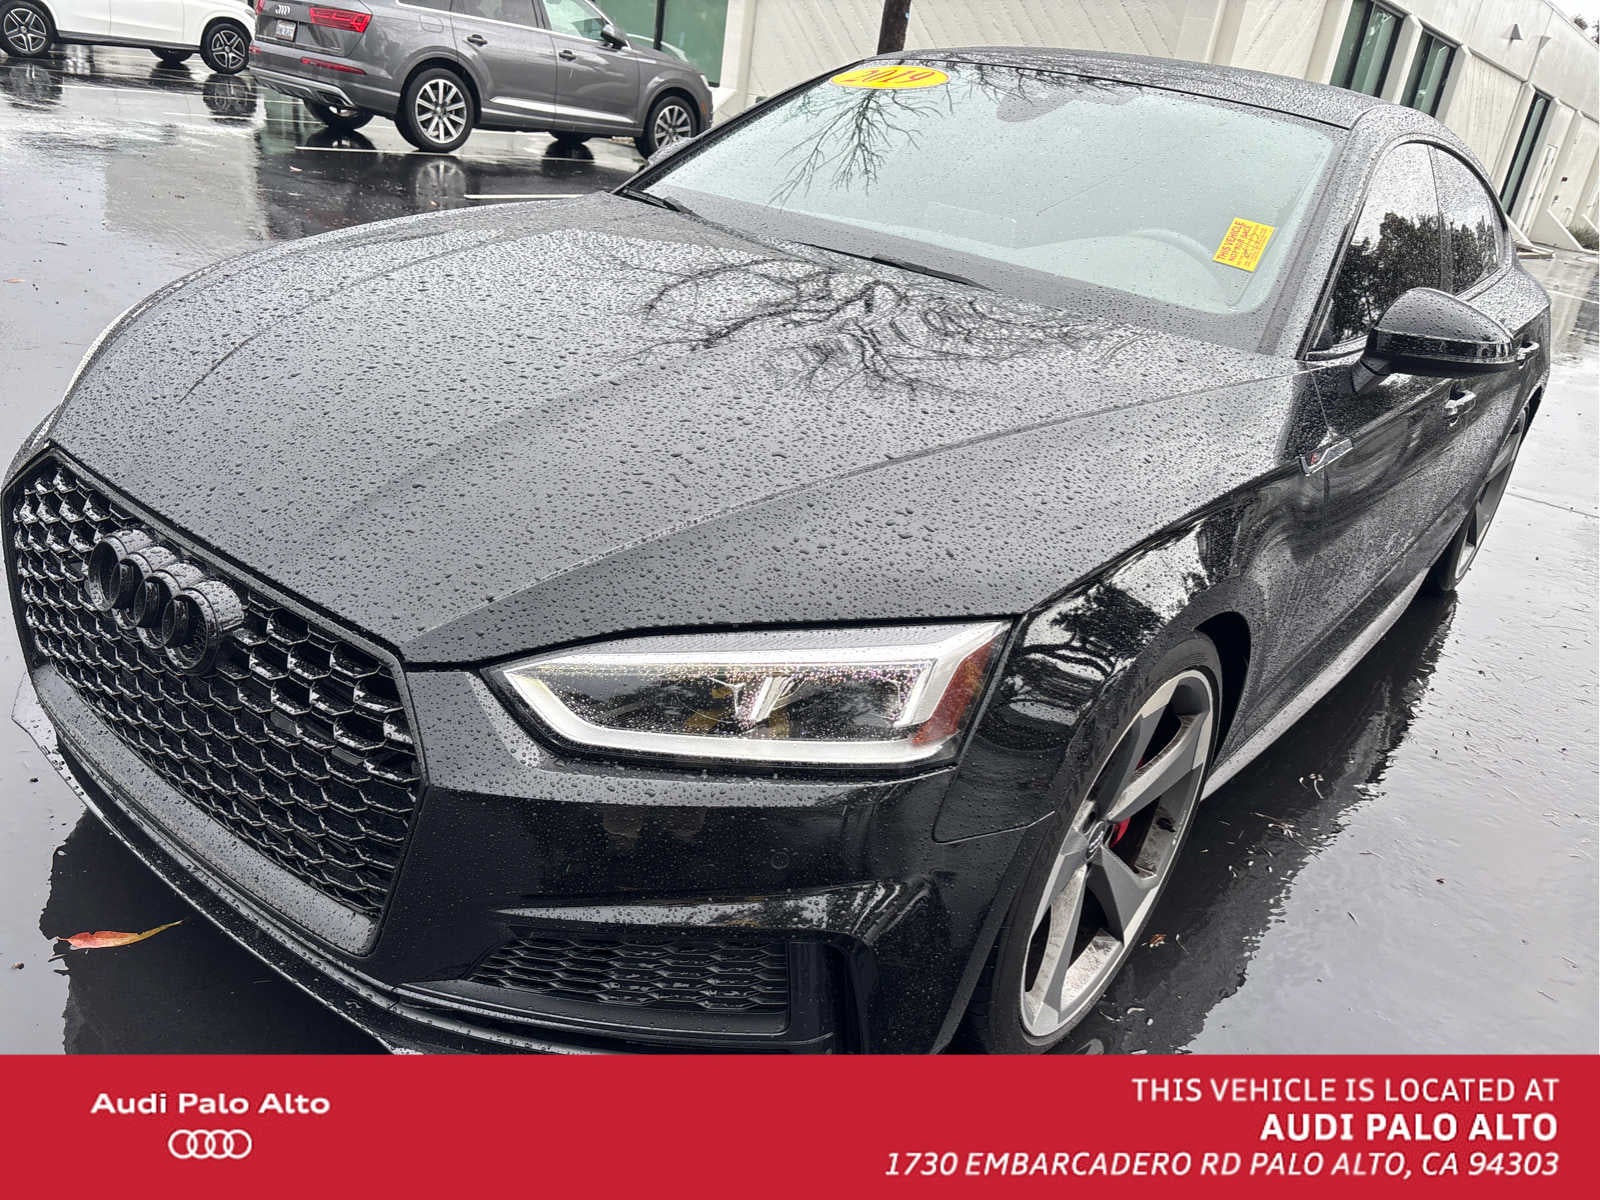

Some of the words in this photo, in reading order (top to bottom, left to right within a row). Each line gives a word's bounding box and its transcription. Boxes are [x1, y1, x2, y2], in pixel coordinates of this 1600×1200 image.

[842, 69, 936, 84] 2019
[1223, 220, 1242, 246] VEHICLE
[1216, 245, 1231, 260] THIS
